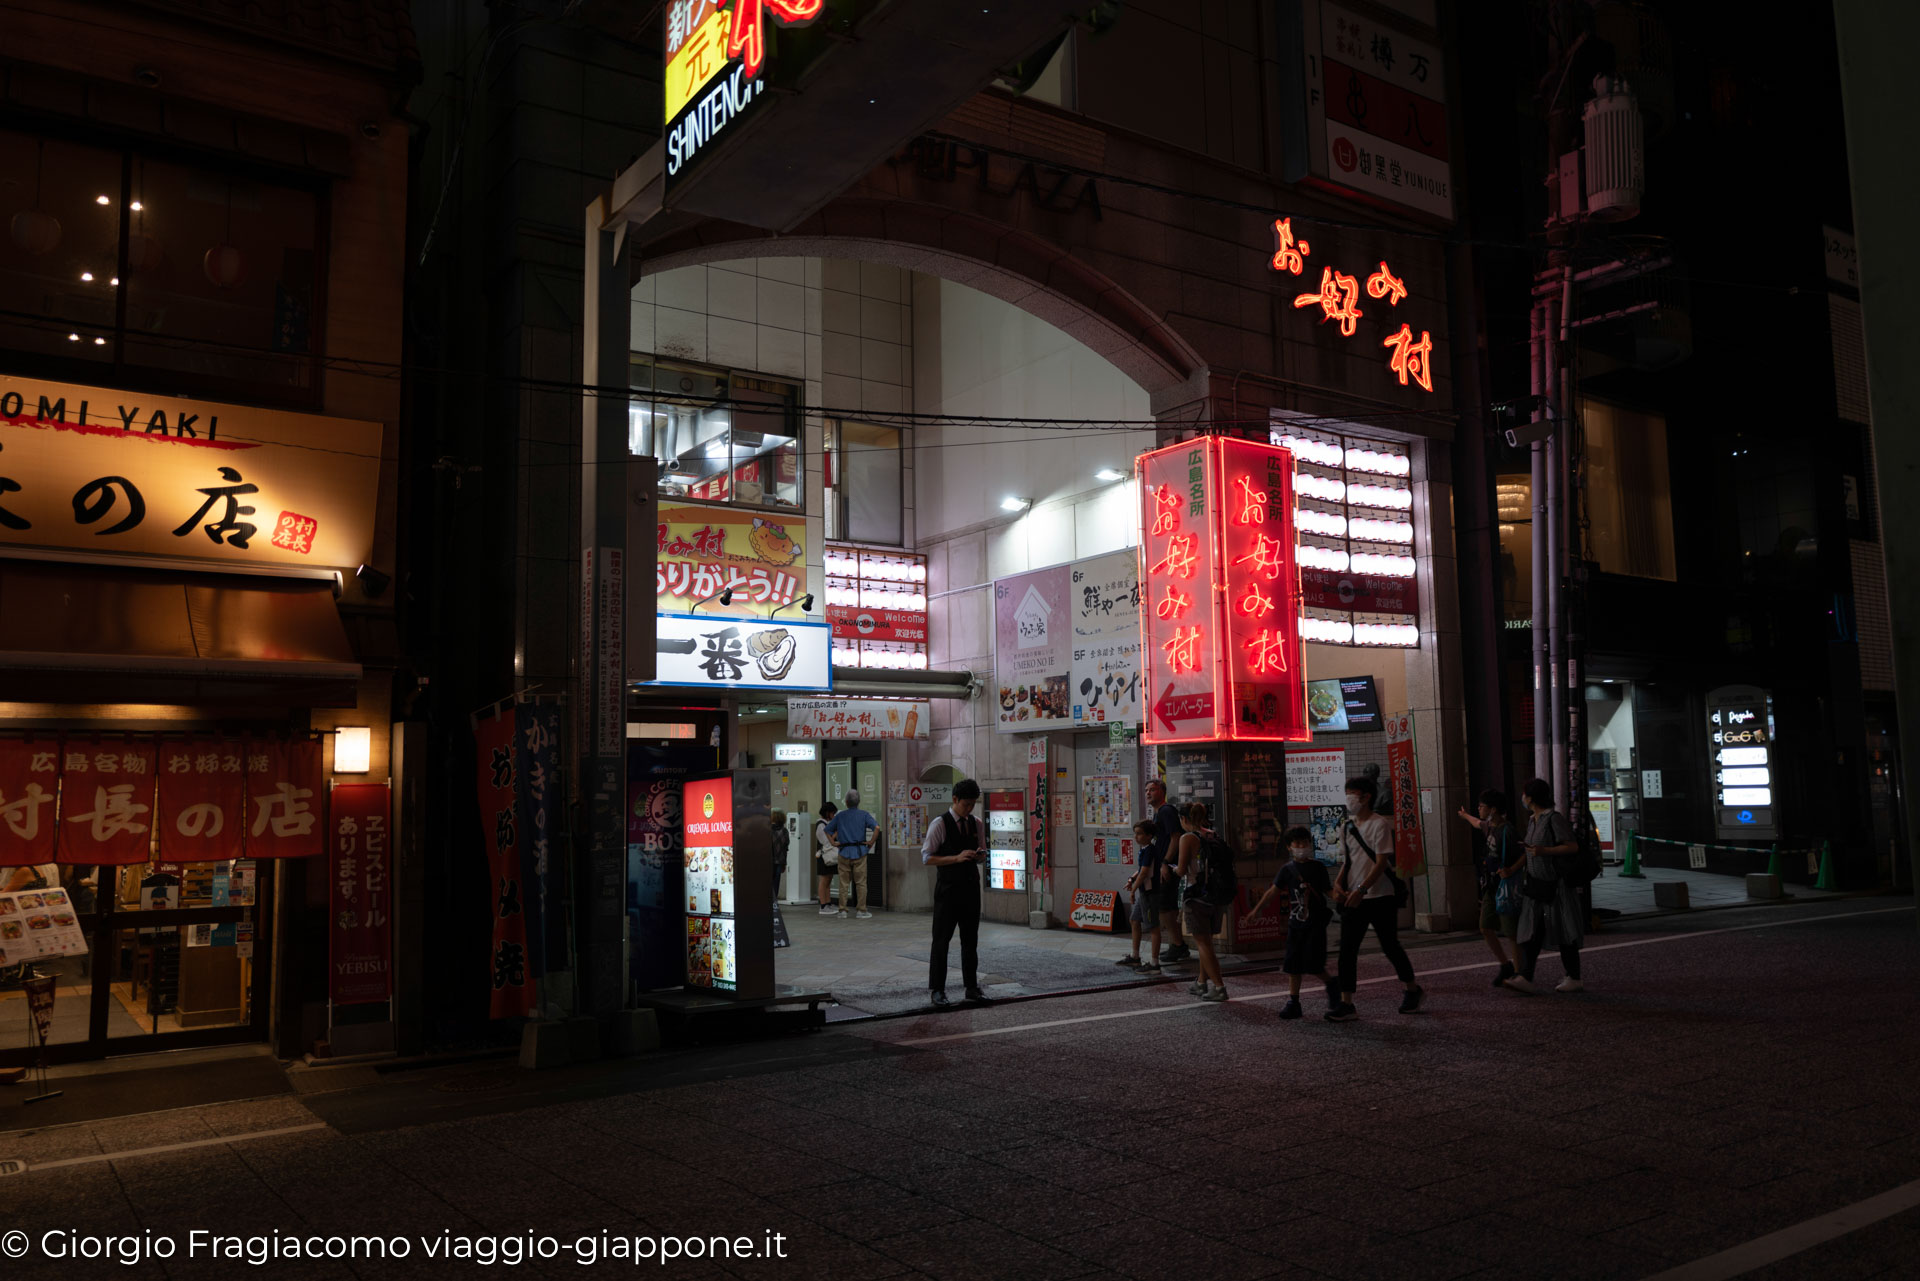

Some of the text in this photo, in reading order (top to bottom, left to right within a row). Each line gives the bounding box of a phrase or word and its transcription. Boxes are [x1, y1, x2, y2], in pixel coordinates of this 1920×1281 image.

[668, 63, 765, 176] SHINTENC
[1404, 169, 1448, 199] YUNIQUE
[117, 404, 219, 441] YAKI
[1187, 448, 1205, 518] 広島名所
[1267, 455, 1284, 522] 広島名所
[1072, 571, 1084, 583] 6F
[1149, 482, 1202, 674] お好み村
[1231, 475, 1288, 674] お好み村
[1365, 577, 1404, 592] Welcome
[838, 618, 891, 629] OKONOMIMURA
[884, 612, 926, 624] Welcome
[1073, 649, 1086, 661] 5F
[1013, 656, 1055, 670] UMEKO NO IE
[1165, 698, 1212, 718] エレベーター
[687, 821, 733, 836] ORIENTAL LOUNGE
[1075, 893, 1113, 907] お好み村
[335, 960, 388, 975] YEBISU
